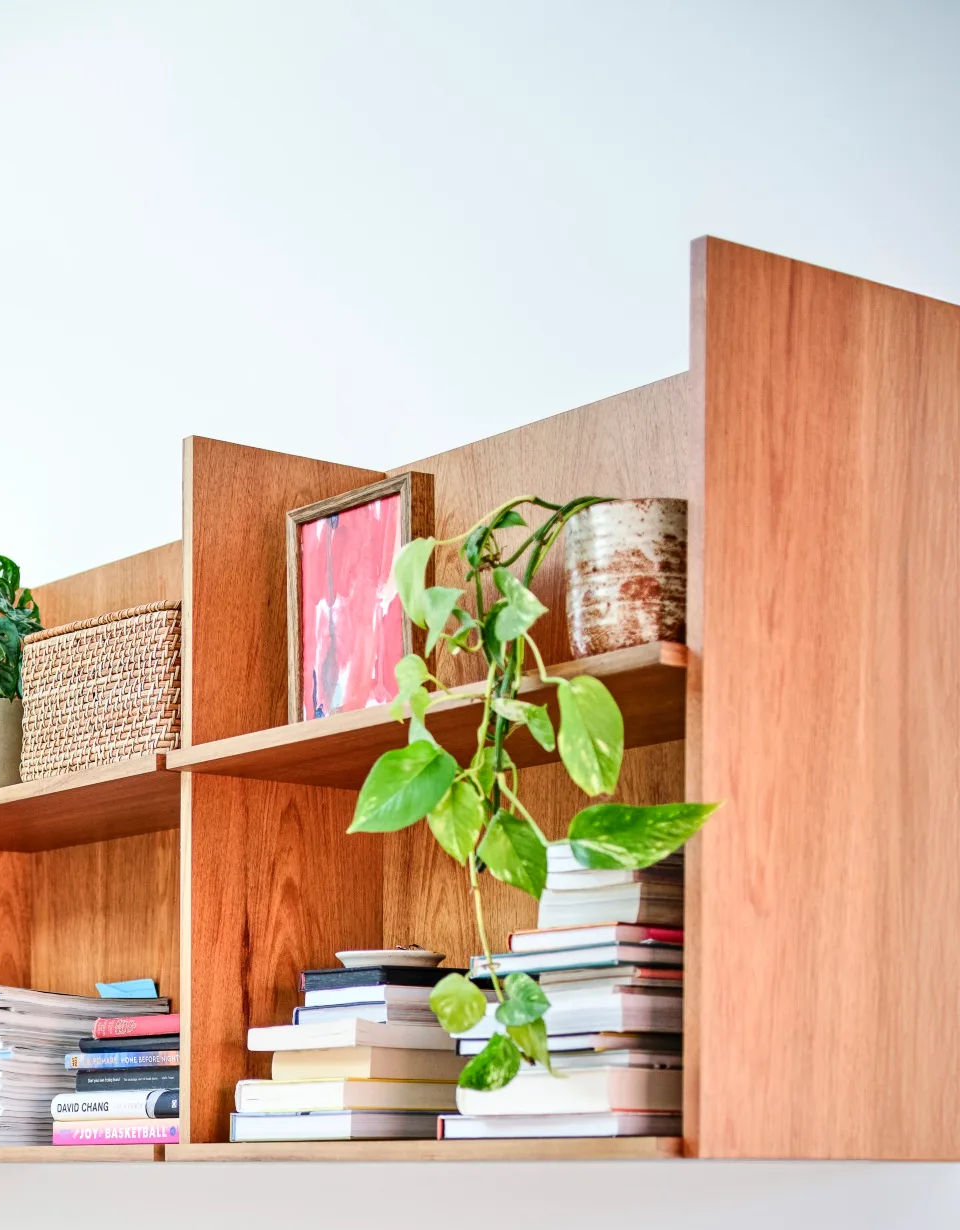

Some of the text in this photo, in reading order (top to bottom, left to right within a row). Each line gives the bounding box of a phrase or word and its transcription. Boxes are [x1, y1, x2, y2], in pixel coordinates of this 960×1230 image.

[121, 1056, 137, 1064] HOME
[138, 1055, 160, 1063] BEFORE
[161, 1054, 180, 1063] NIGHT
[57, 1103, 79, 1113] DAVID
[81, 1101, 109, 1112] CHANG
[79, 1127, 98, 1139] JOY
[105, 1126, 167, 1139] BASKETBALL
